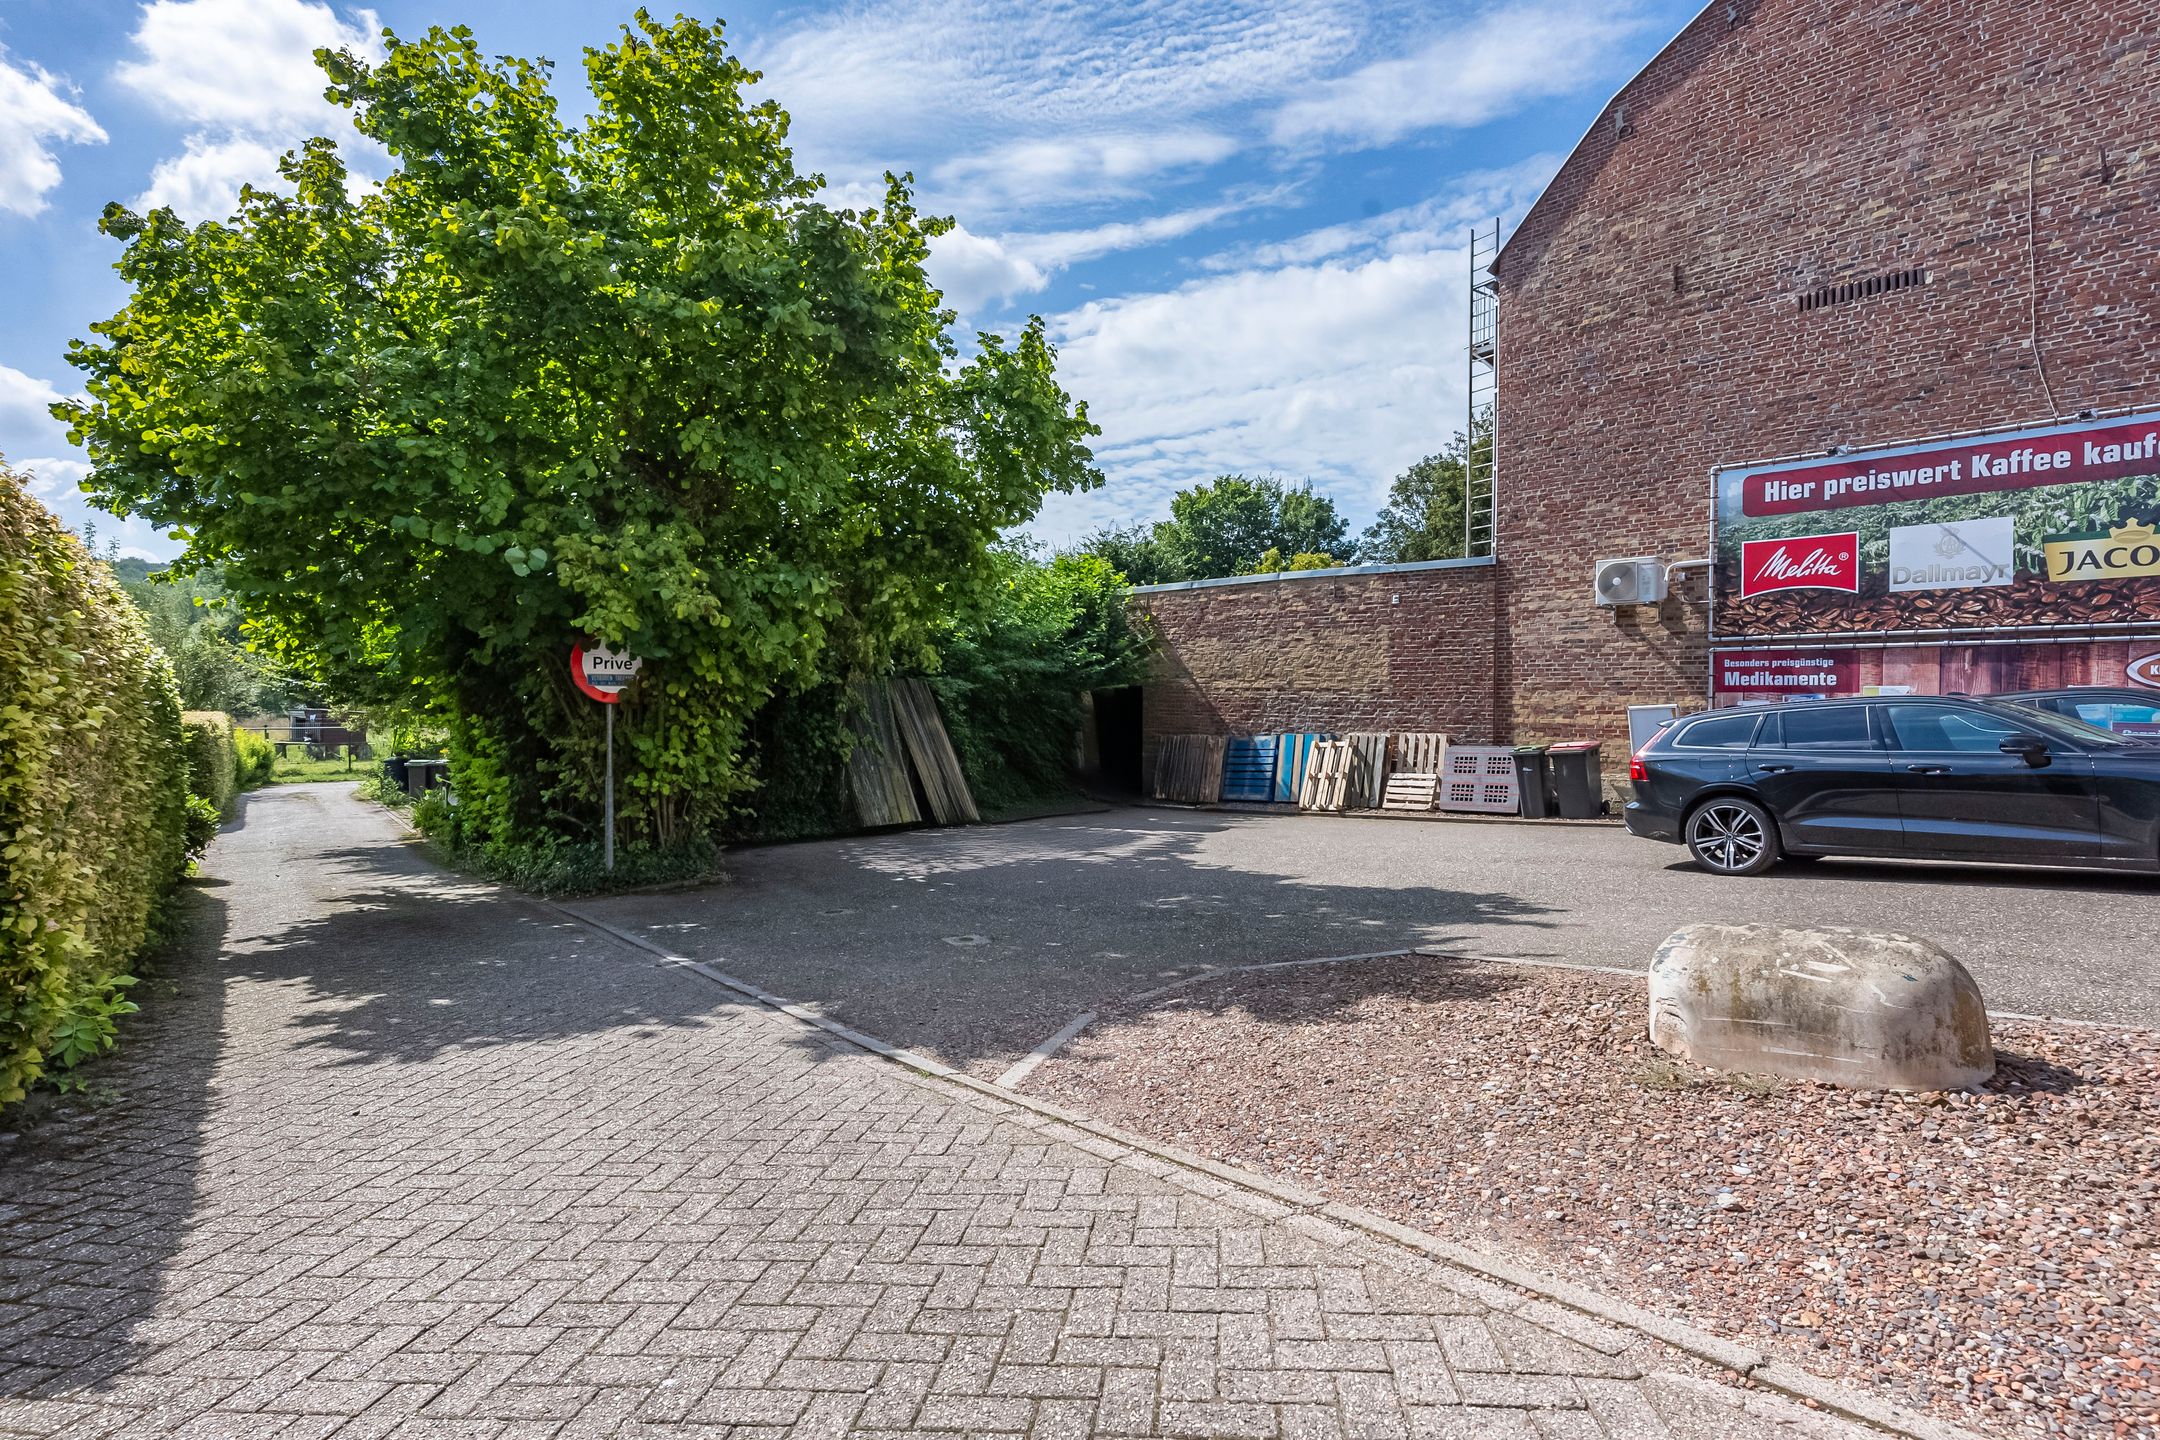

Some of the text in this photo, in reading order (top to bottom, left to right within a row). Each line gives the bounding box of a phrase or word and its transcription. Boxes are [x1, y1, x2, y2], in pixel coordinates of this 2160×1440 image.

[1764, 432, 2160, 503] Hier preiswert Kaffee kauf
[1753, 545, 1841, 583] Melitta
[1892, 563, 2010, 585] Dallmayr
[1724, 658, 1834, 668] Besonders preisgünstige
[1724, 671, 1837, 686] Medikamente
